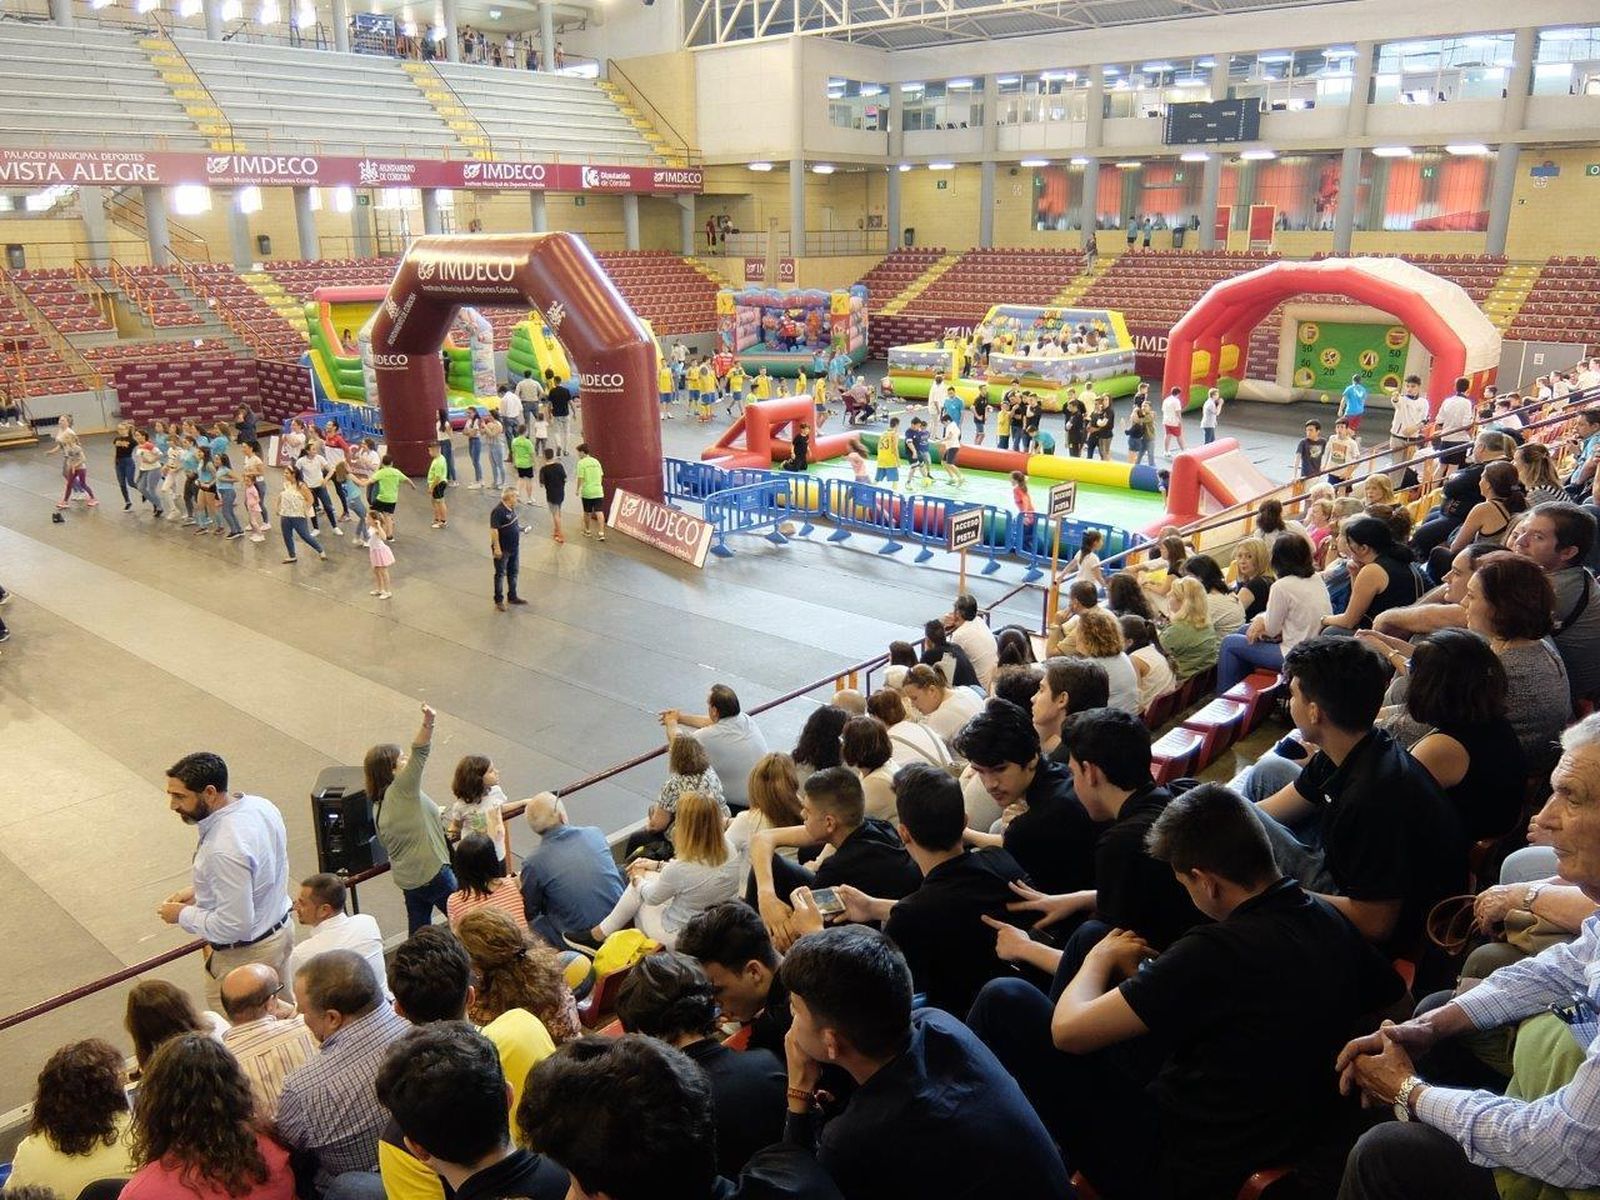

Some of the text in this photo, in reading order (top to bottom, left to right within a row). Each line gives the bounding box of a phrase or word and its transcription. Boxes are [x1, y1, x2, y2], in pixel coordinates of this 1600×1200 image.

[49, 151, 99, 161] MUNICIPAL
[101, 152, 145, 162] DEPORTES
[0, 162, 160, 181] VISTA ALEGRE
[233, 156, 318, 175] IMDECO
[483, 163, 546, 180] IMDECO
[665, 171, 702, 183] IMDECO
[439, 258, 515, 281] IMDECO
[1135, 335, 1169, 351] IMD
[1302, 344, 1313, 353] 50
[1389, 349, 1401, 357] 50
[375, 354, 409, 366] DECO
[1300, 359, 1311, 368] 50
[1323, 368, 1335, 376] 20
[1361, 370, 1374, 378] 20
[1388, 364, 1400, 373] 50
[637, 500, 700, 546] IMDECO
[955, 518, 979, 531] ACCESO
[956, 530, 976, 543] PISTA
